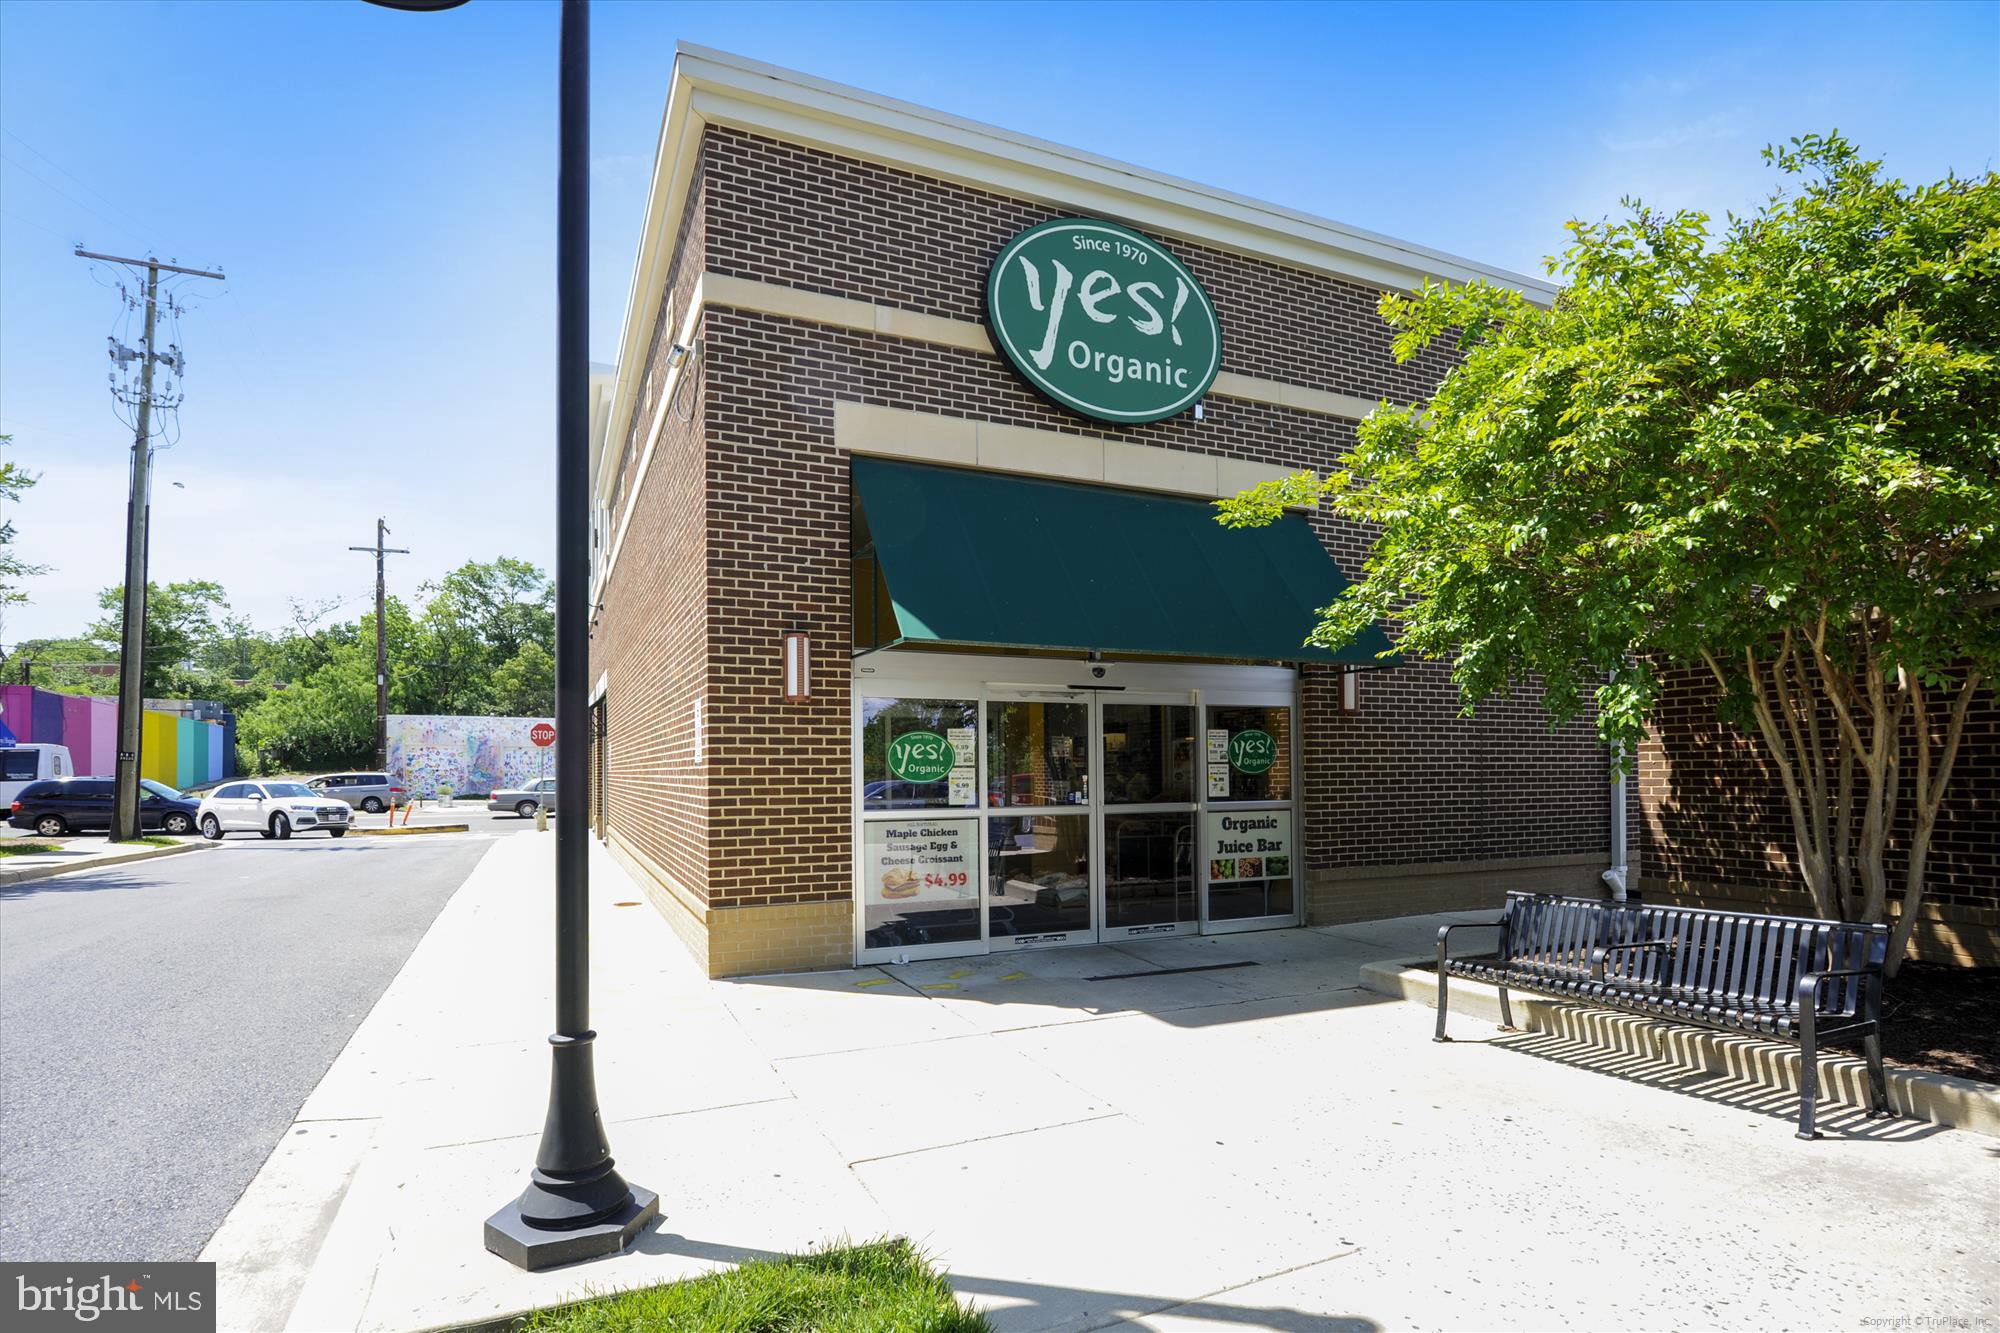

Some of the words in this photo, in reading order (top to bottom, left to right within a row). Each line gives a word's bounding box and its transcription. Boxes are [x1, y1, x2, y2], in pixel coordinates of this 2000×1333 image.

[1072, 235, 1110, 252] Since
[1115, 241, 1147, 265] 1970
[1068, 340, 1188, 388] Organic
[532, 731, 554, 740] STOP
[1244, 757, 1270, 766] Organic
[908, 764, 945, 774] Organic
[1222, 816, 1278, 833] Organic
[886, 829, 918, 839] Maple
[920, 828, 958, 837] Chicken
[886, 843, 927, 852] Sausage
[930, 841, 948, 851] Egg
[950, 841, 958, 849] &
[1217, 840, 1253, 854] Juice
[1257, 839, 1282, 852] Bar
[881, 857, 915, 865] Cheese
[918, 855, 963, 864] Croissant
[924, 872, 967, 888] $4.99
